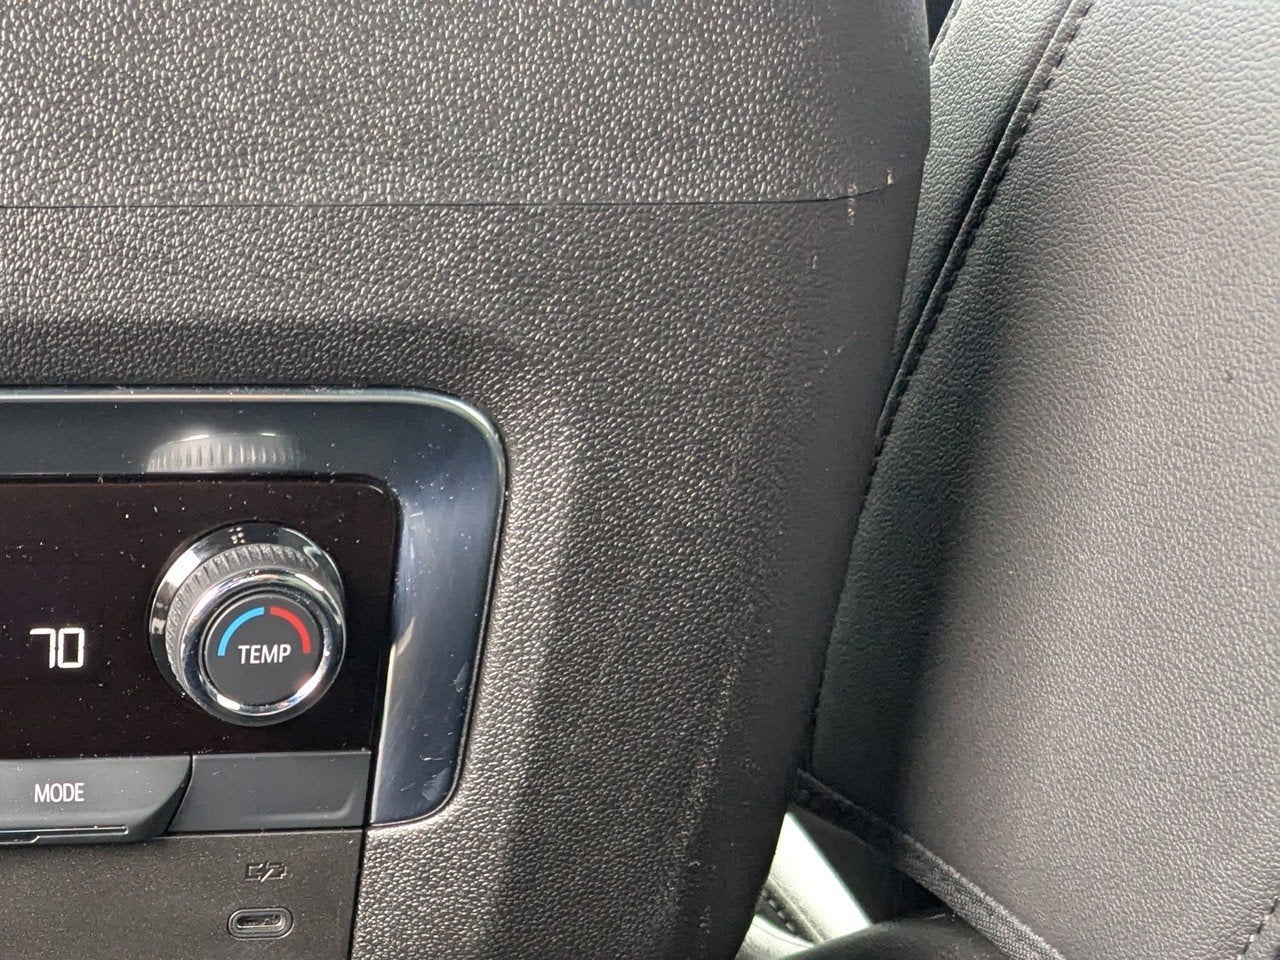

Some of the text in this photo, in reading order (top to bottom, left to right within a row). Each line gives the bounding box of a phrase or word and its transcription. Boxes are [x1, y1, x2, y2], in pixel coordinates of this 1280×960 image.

[29, 627, 84, 668] 70
[237, 644, 291, 665] TEMP
[33, 783, 85, 803] MODE
